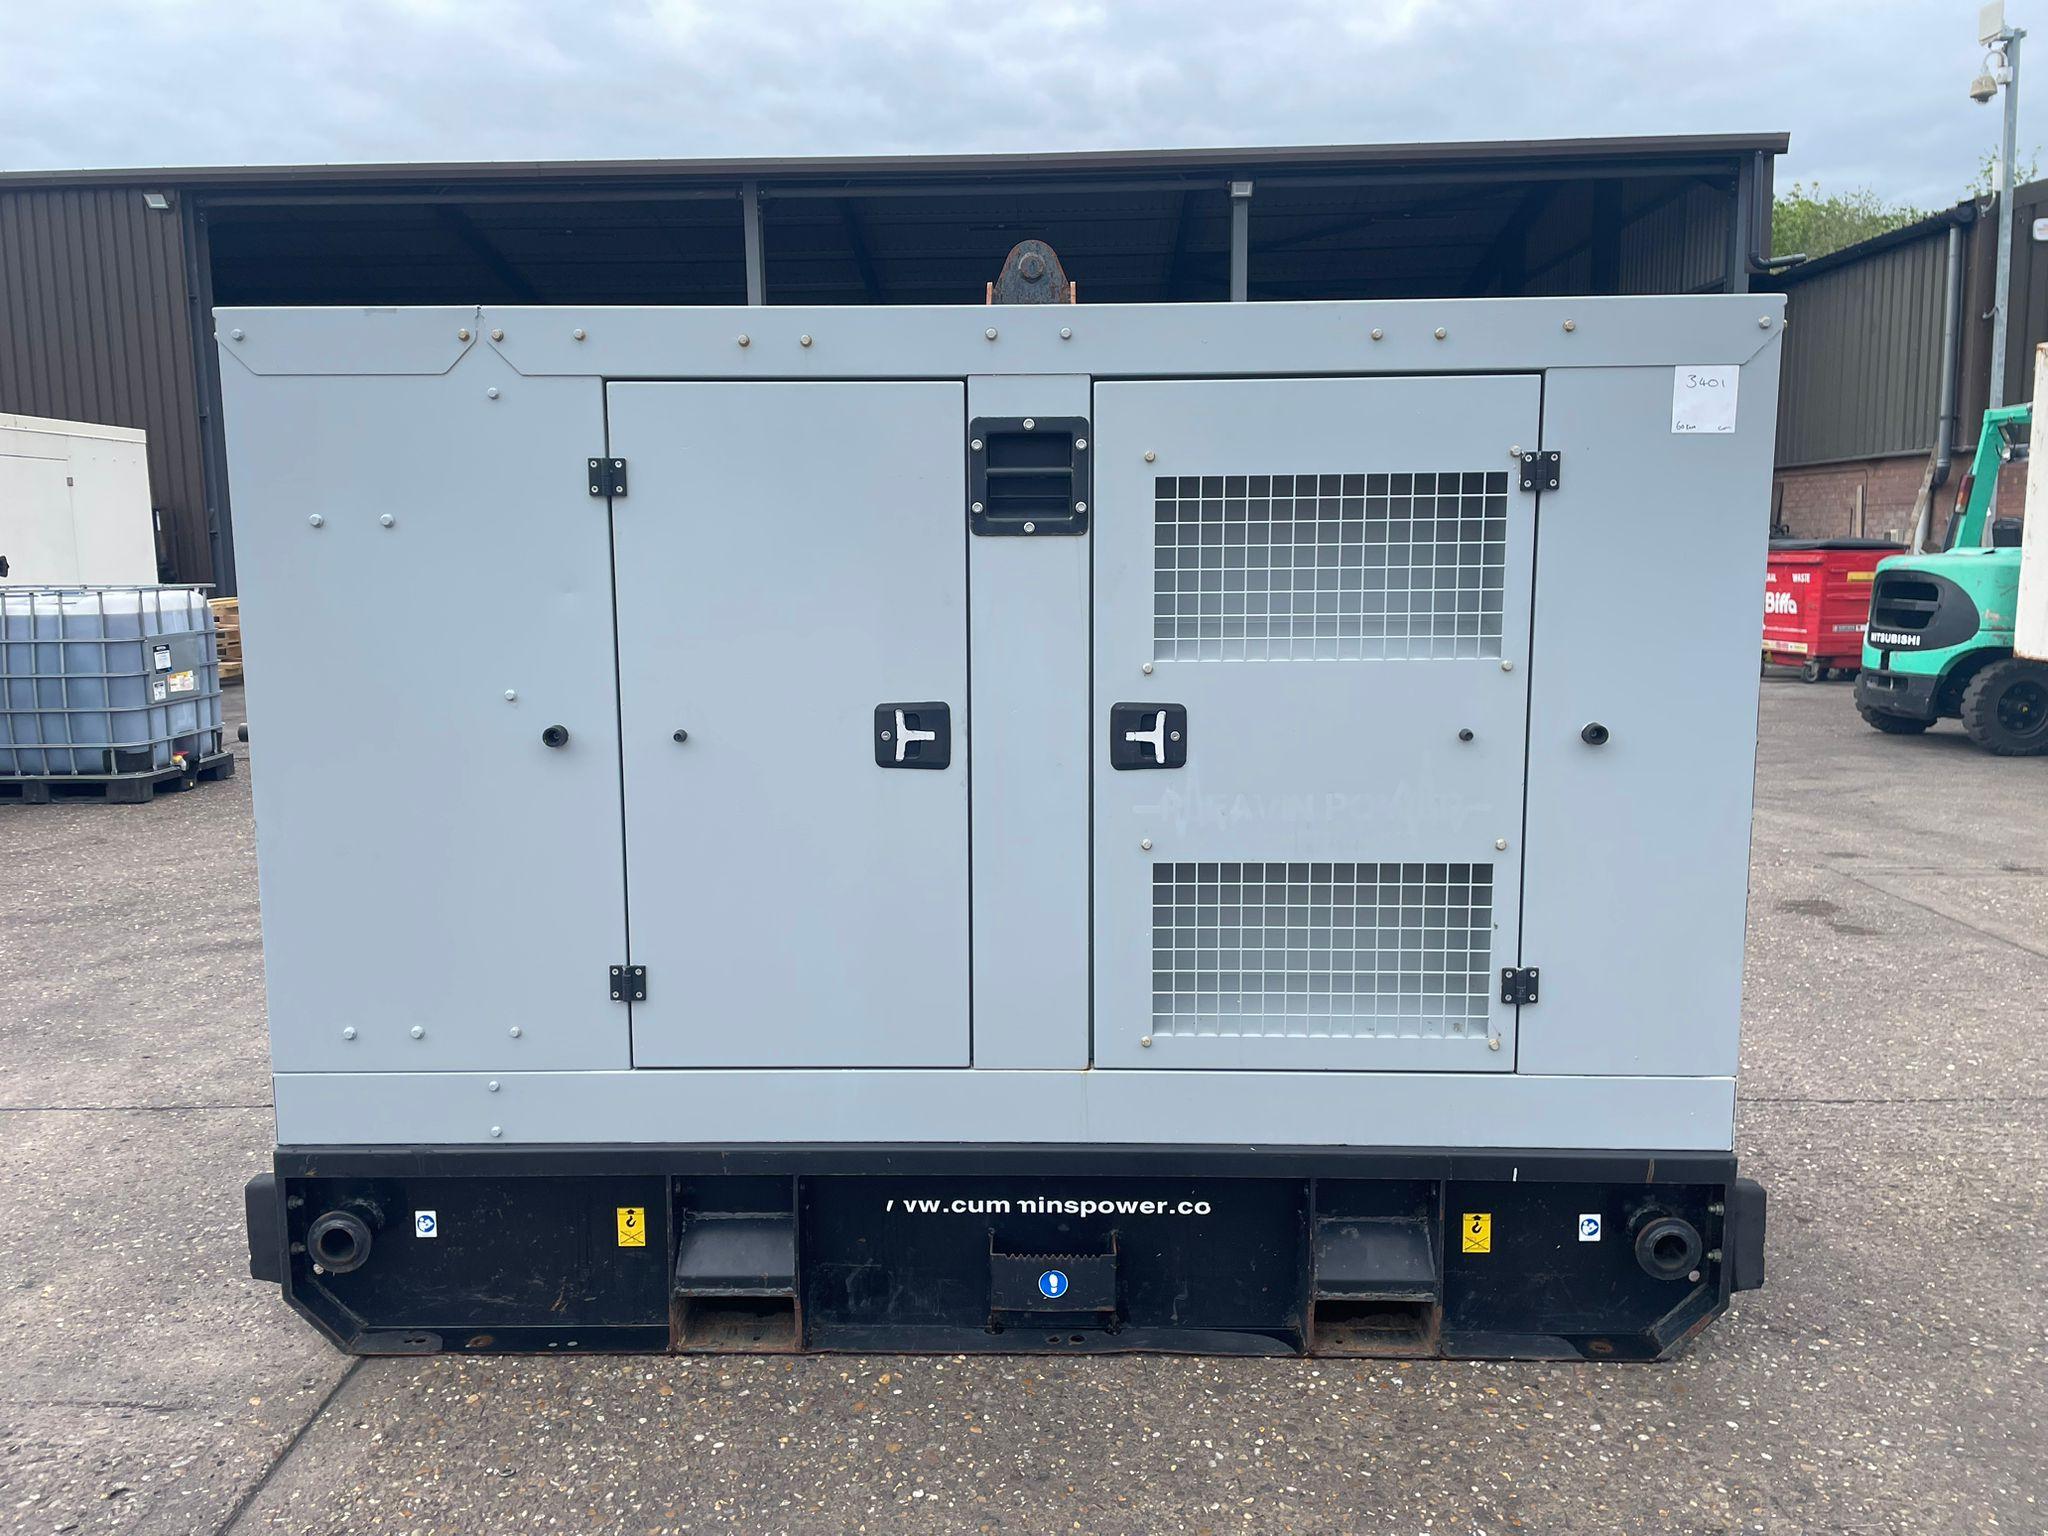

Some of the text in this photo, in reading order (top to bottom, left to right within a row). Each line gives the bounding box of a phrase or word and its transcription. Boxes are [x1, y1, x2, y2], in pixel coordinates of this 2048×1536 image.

[1686, 374, 1725, 388] 3401
[1791, 572, 1811, 583] WASTE
[1765, 591, 1798, 614] Biffa
[1870, 632, 1920, 646] MITSUBISHI
